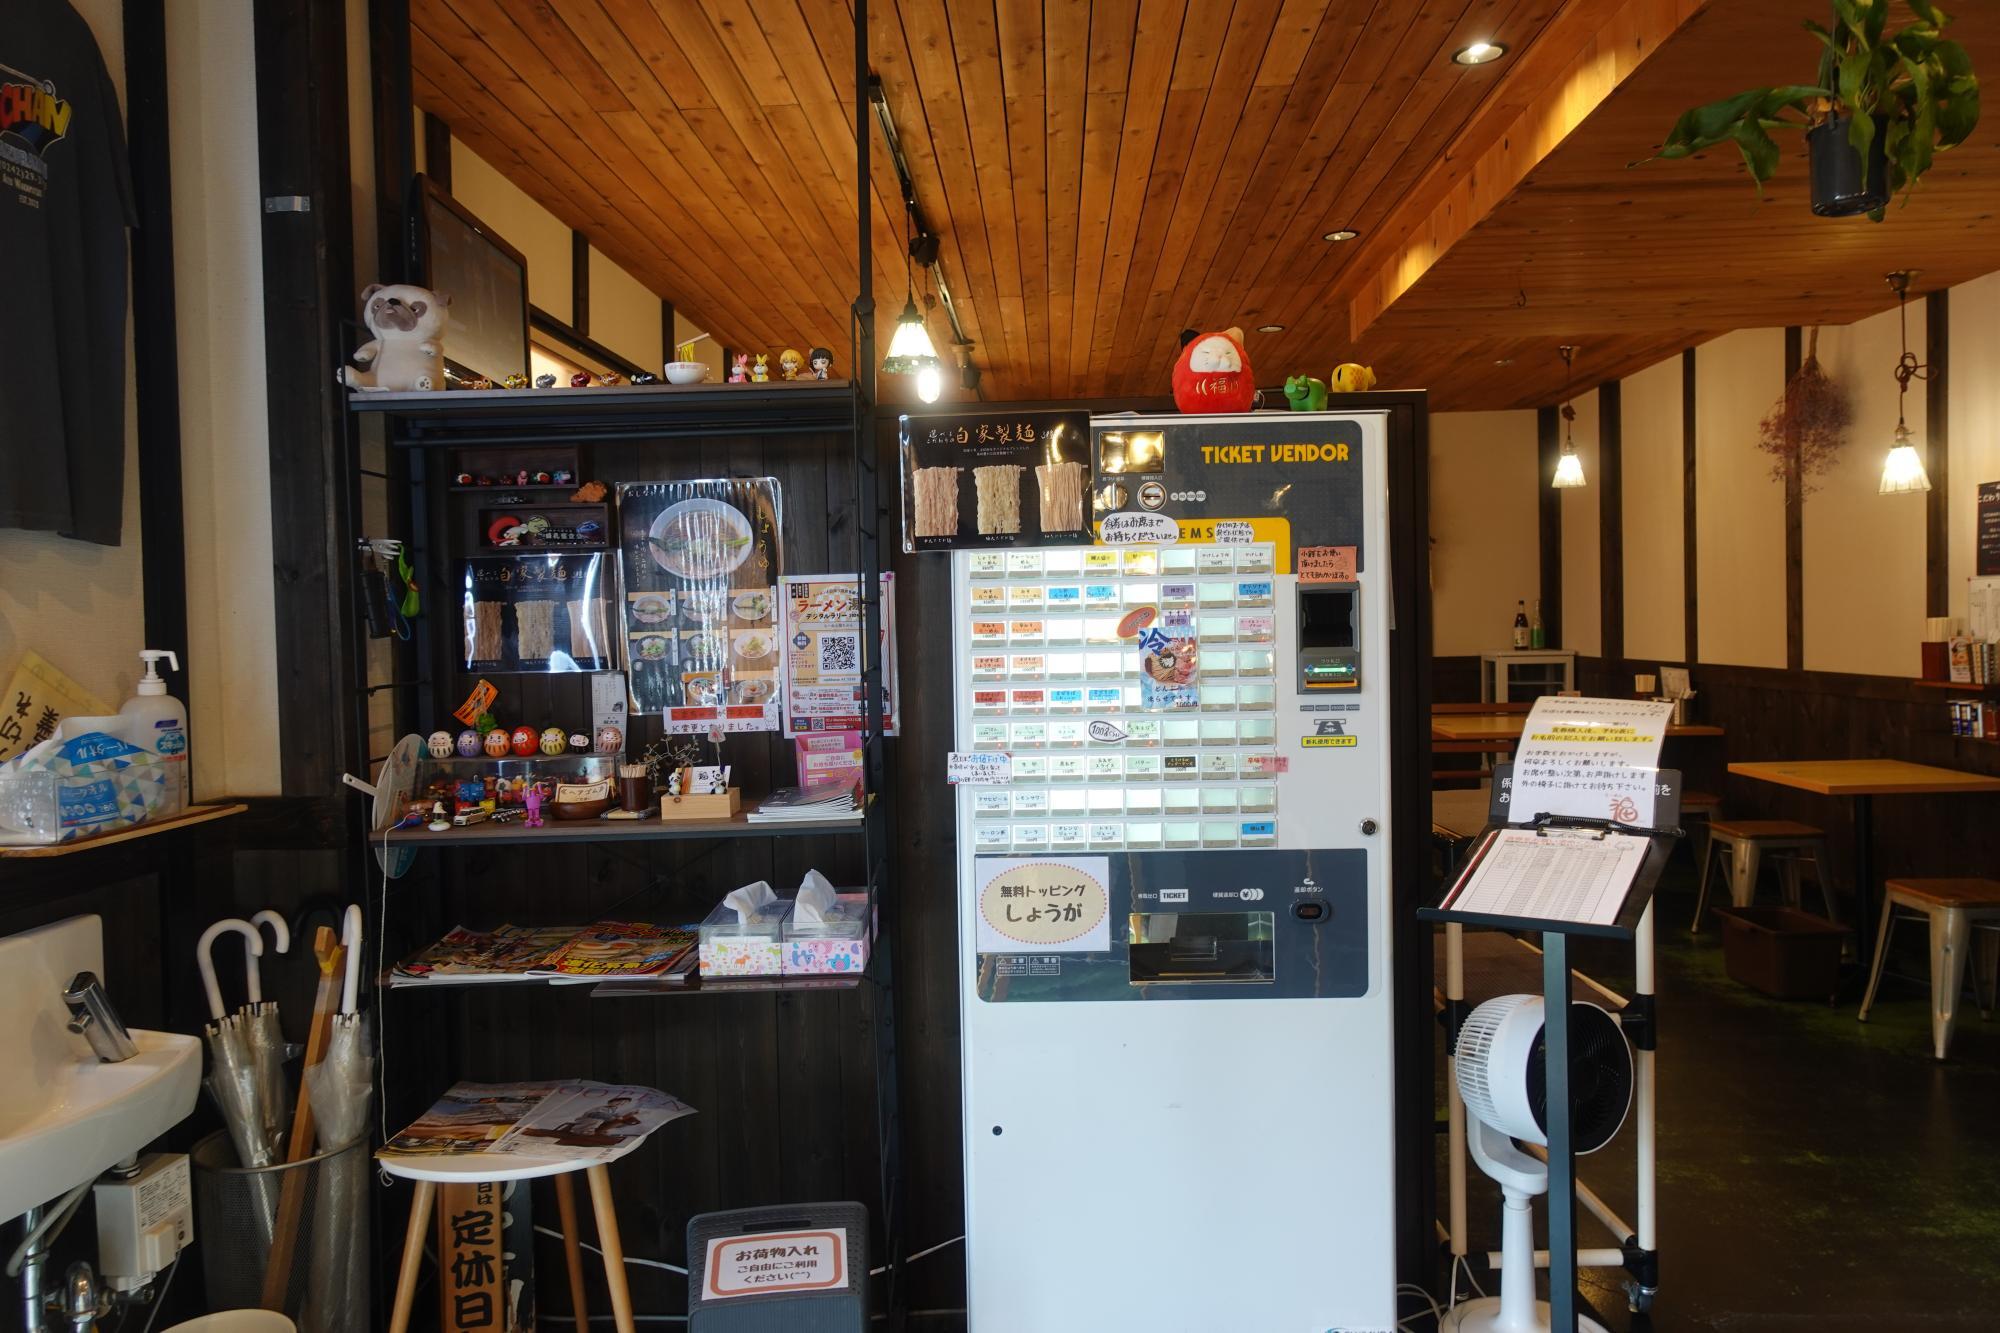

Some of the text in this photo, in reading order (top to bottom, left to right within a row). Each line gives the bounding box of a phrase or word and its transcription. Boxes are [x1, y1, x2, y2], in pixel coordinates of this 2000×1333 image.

[956, 423, 1036, 445] 自家製麺
[1201, 444, 1349, 464] TICKET VENDOR
[1000, 884, 1086, 898] 無料トッピング
[1006, 902, 1082, 923] しょうが
[735, 1245, 820, 1262] お荷物入れ
[451, 1210, 496, 1329] 定休日
[737, 1259, 818, 1274] ご自由にご利用
